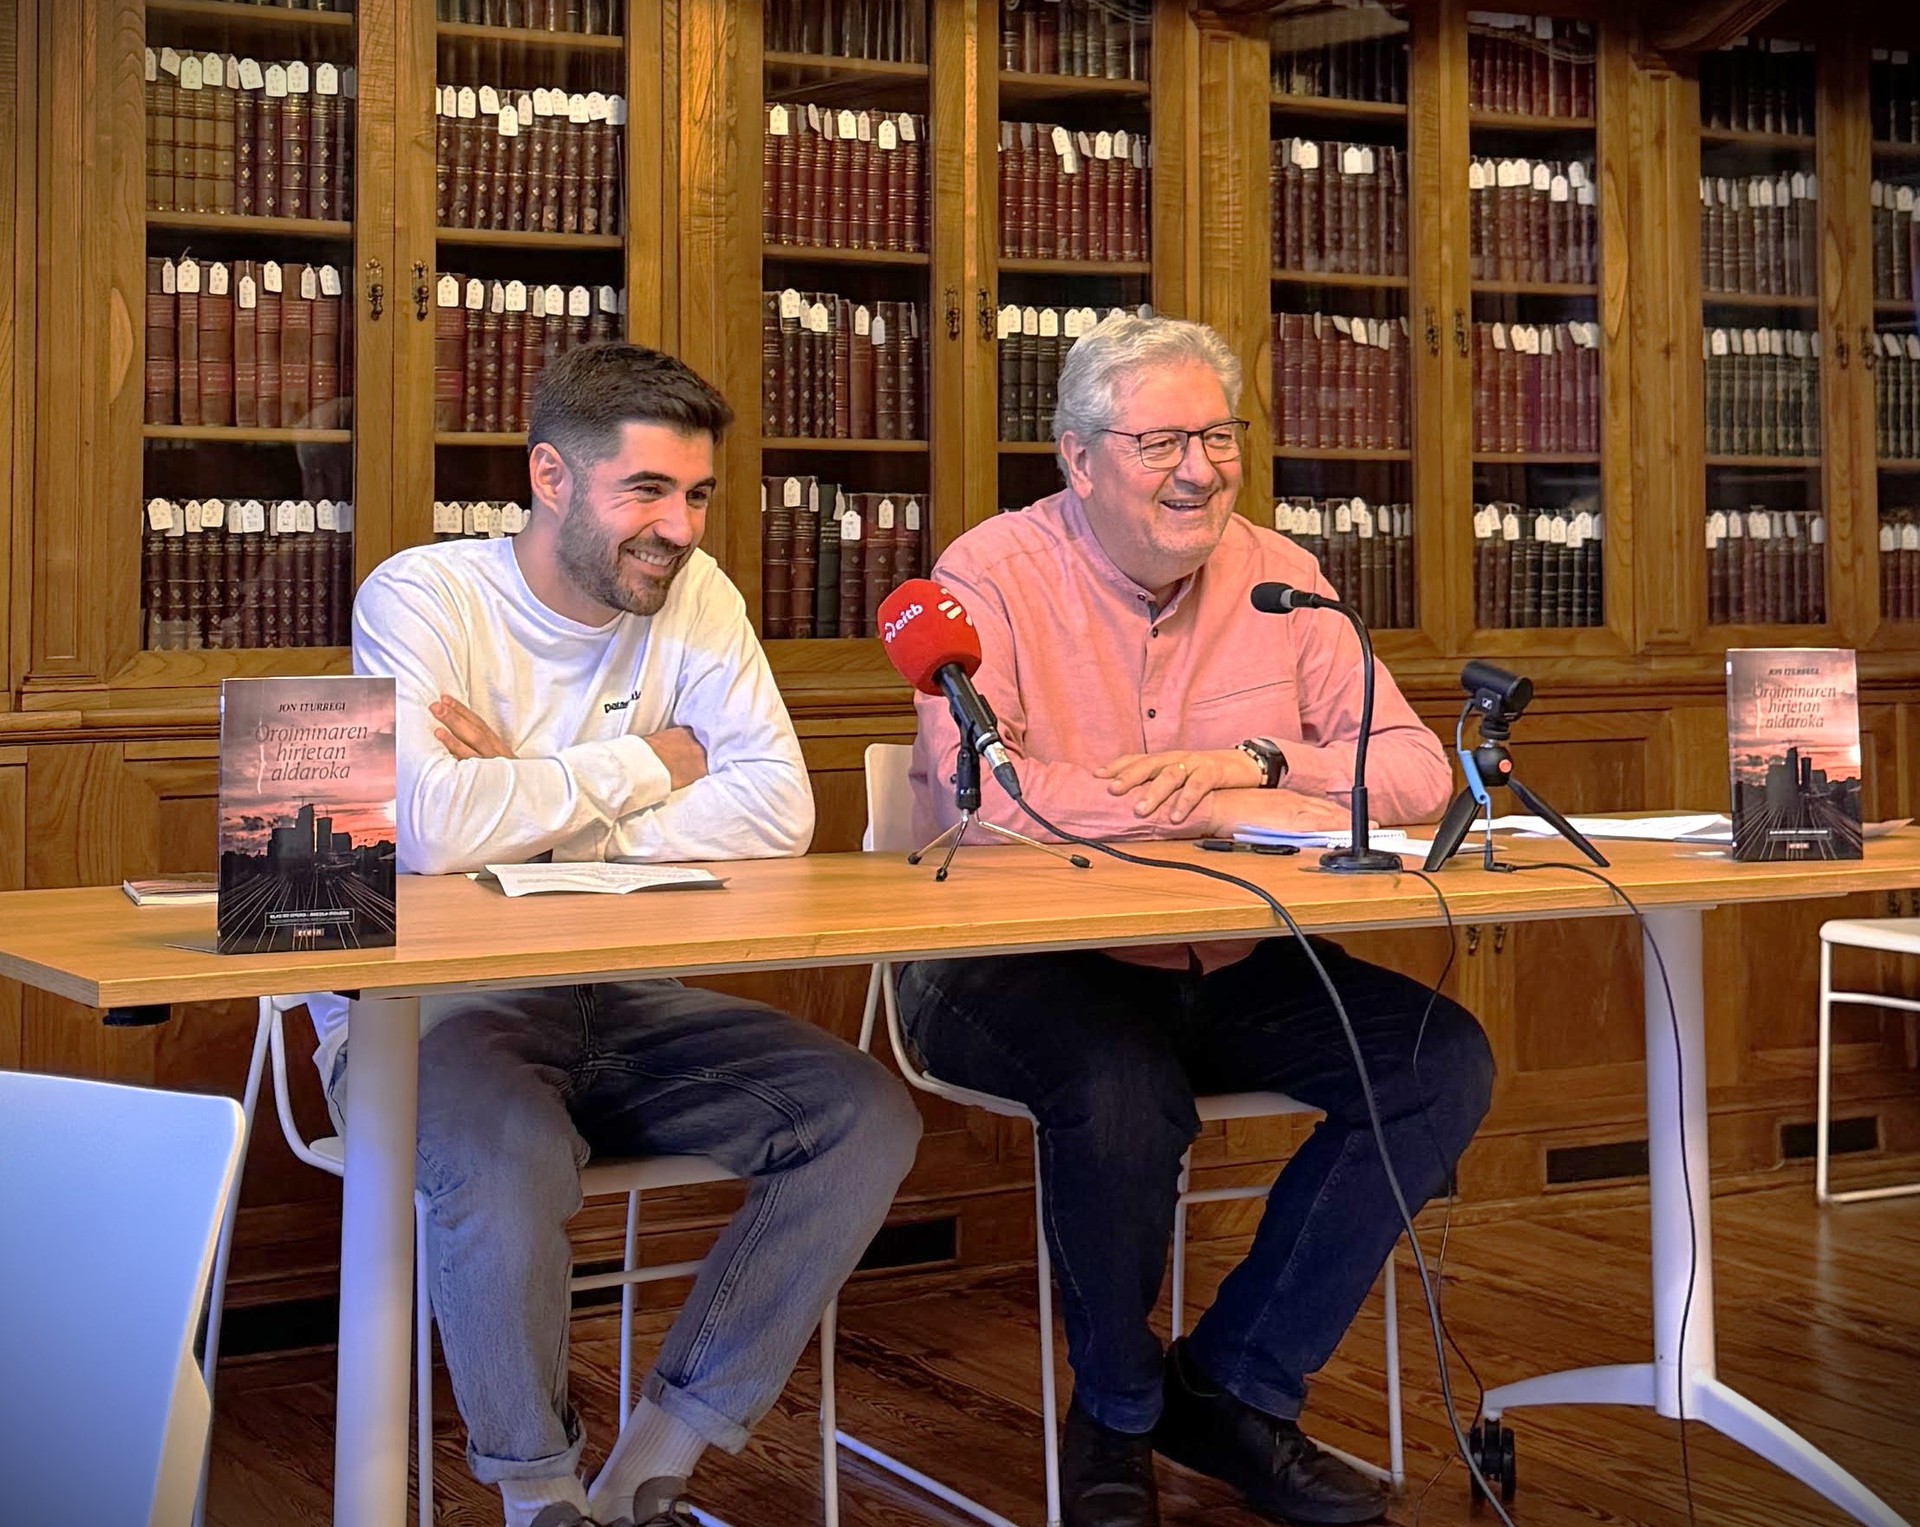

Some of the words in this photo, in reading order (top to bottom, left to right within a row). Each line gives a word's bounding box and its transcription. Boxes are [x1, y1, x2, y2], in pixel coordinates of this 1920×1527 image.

[895, 603, 923, 630] eitb
[278, 702, 297, 713] JON
[299, 702, 346, 712] ITURREGI
[1768, 698, 1821, 714] hirietan
[1765, 713, 1825, 729] aldaroka
[255, 723, 368, 743] Oroiminaren
[276, 743, 347, 762] hirietan
[271, 761, 351, 781] aldaroka
